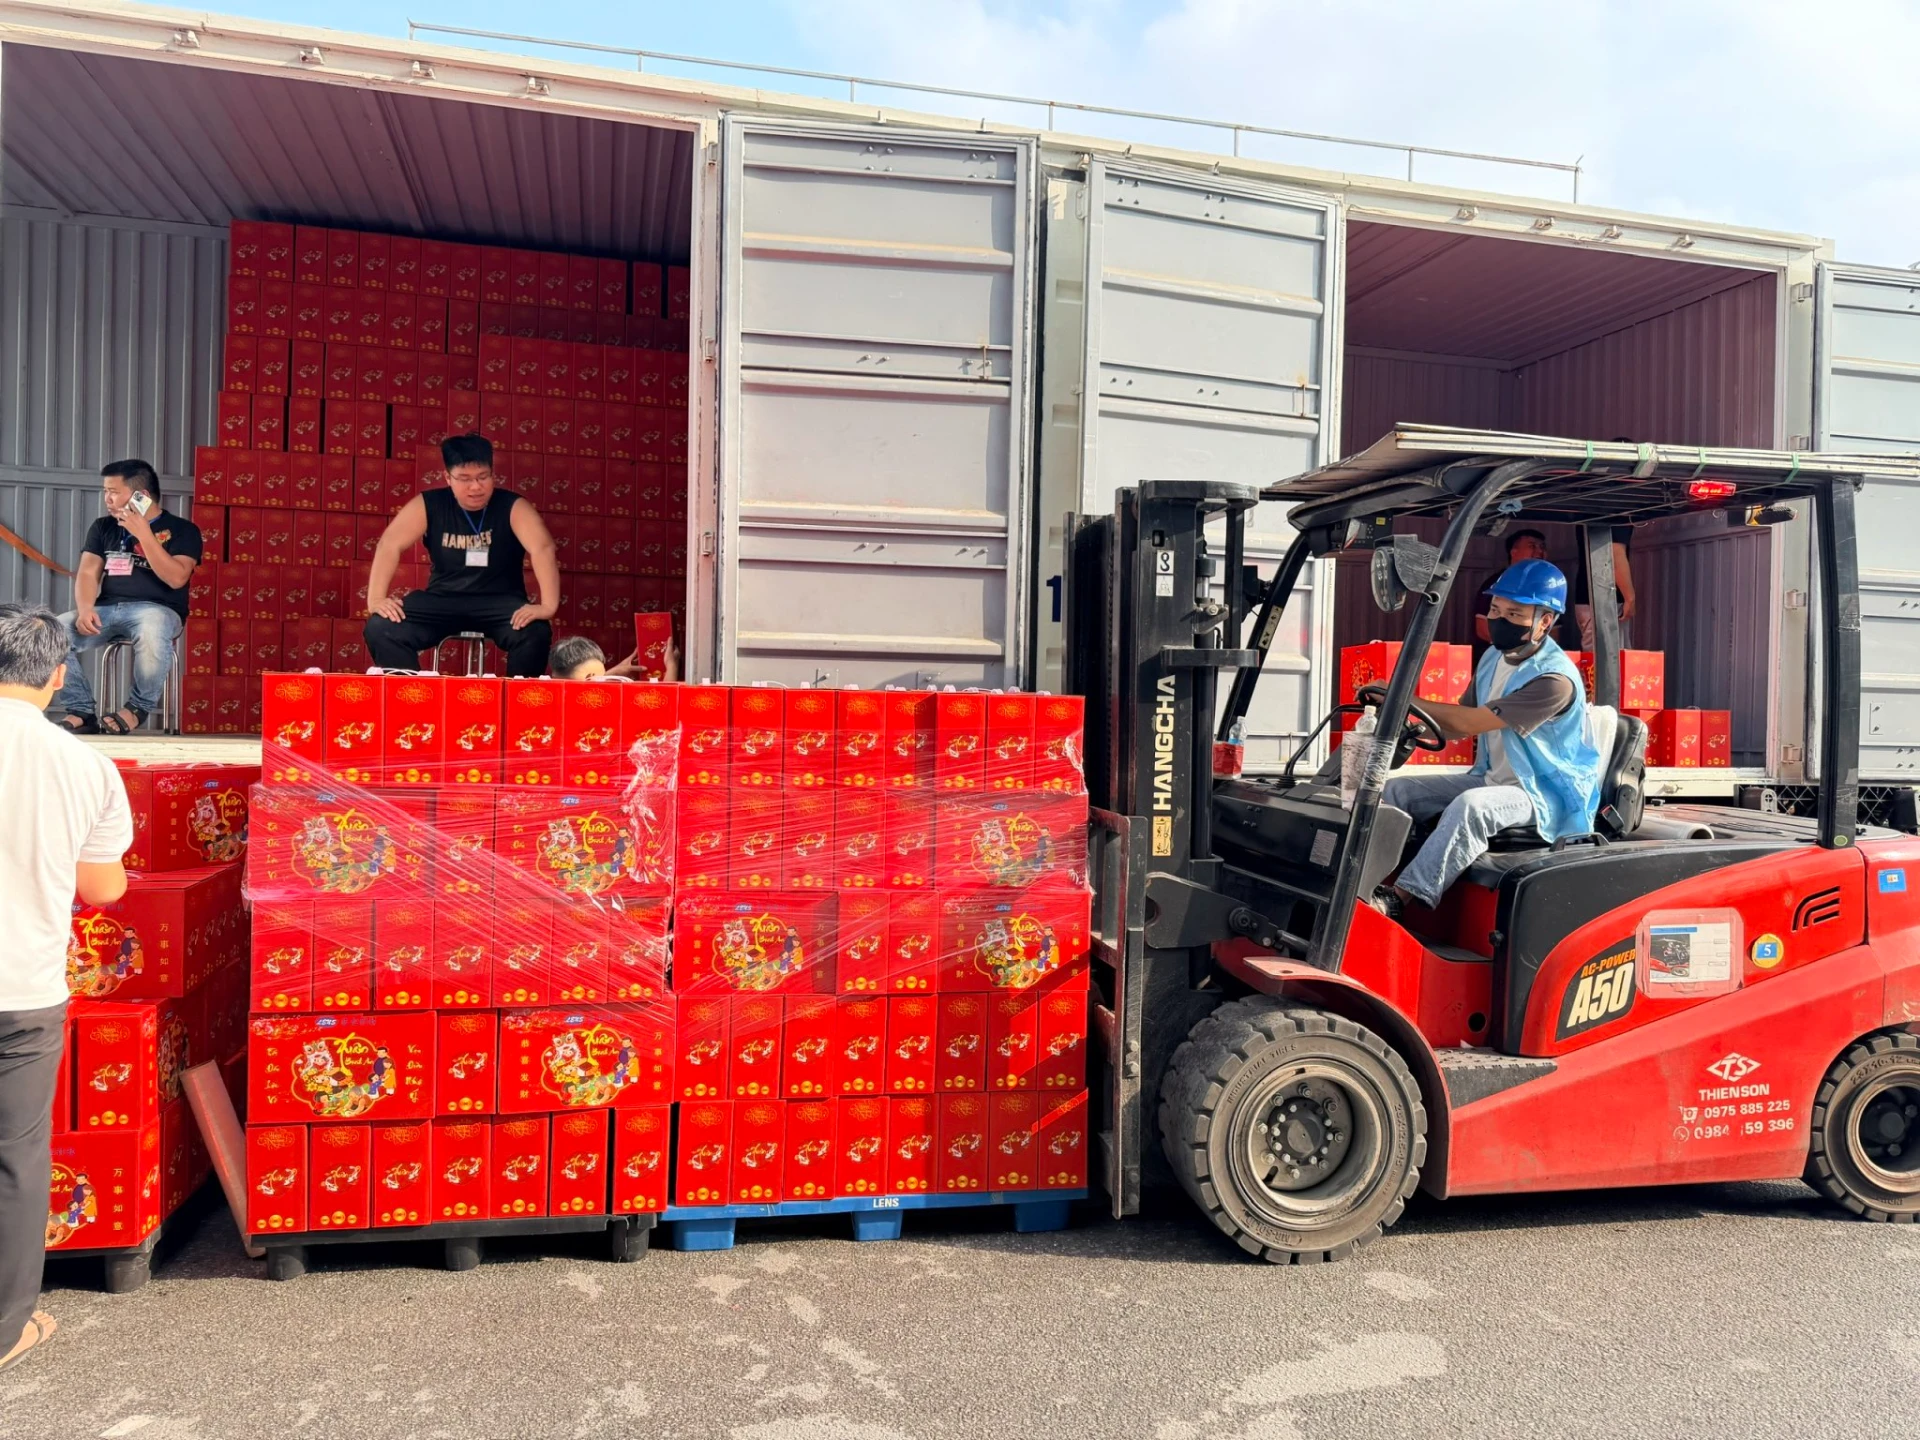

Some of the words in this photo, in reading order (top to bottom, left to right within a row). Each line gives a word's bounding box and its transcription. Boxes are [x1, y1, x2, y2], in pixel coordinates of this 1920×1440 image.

[1153, 674, 1175, 810] HANGCHA
[79, 913, 116, 956] Xuân
[1580, 948, 1636, 978] AC-POWER
[1763, 944, 1771, 956] 5
[1566, 962, 1634, 1028] A50
[333, 1032, 369, 1076] Xuân
[581, 1023, 615, 1066] Xuân
[1720, 1056, 1749, 1081] TS
[1698, 1084, 1770, 1101] THIENSON
[1704, 1105, 1736, 1119] 0975
[1740, 1103, 1763, 1115] 885
[1767, 1100, 1790, 1112] 225
[1740, 1121, 1763, 1136] 59
[1767, 1118, 1794, 1132] 396
[872, 1197, 900, 1208] LENS
